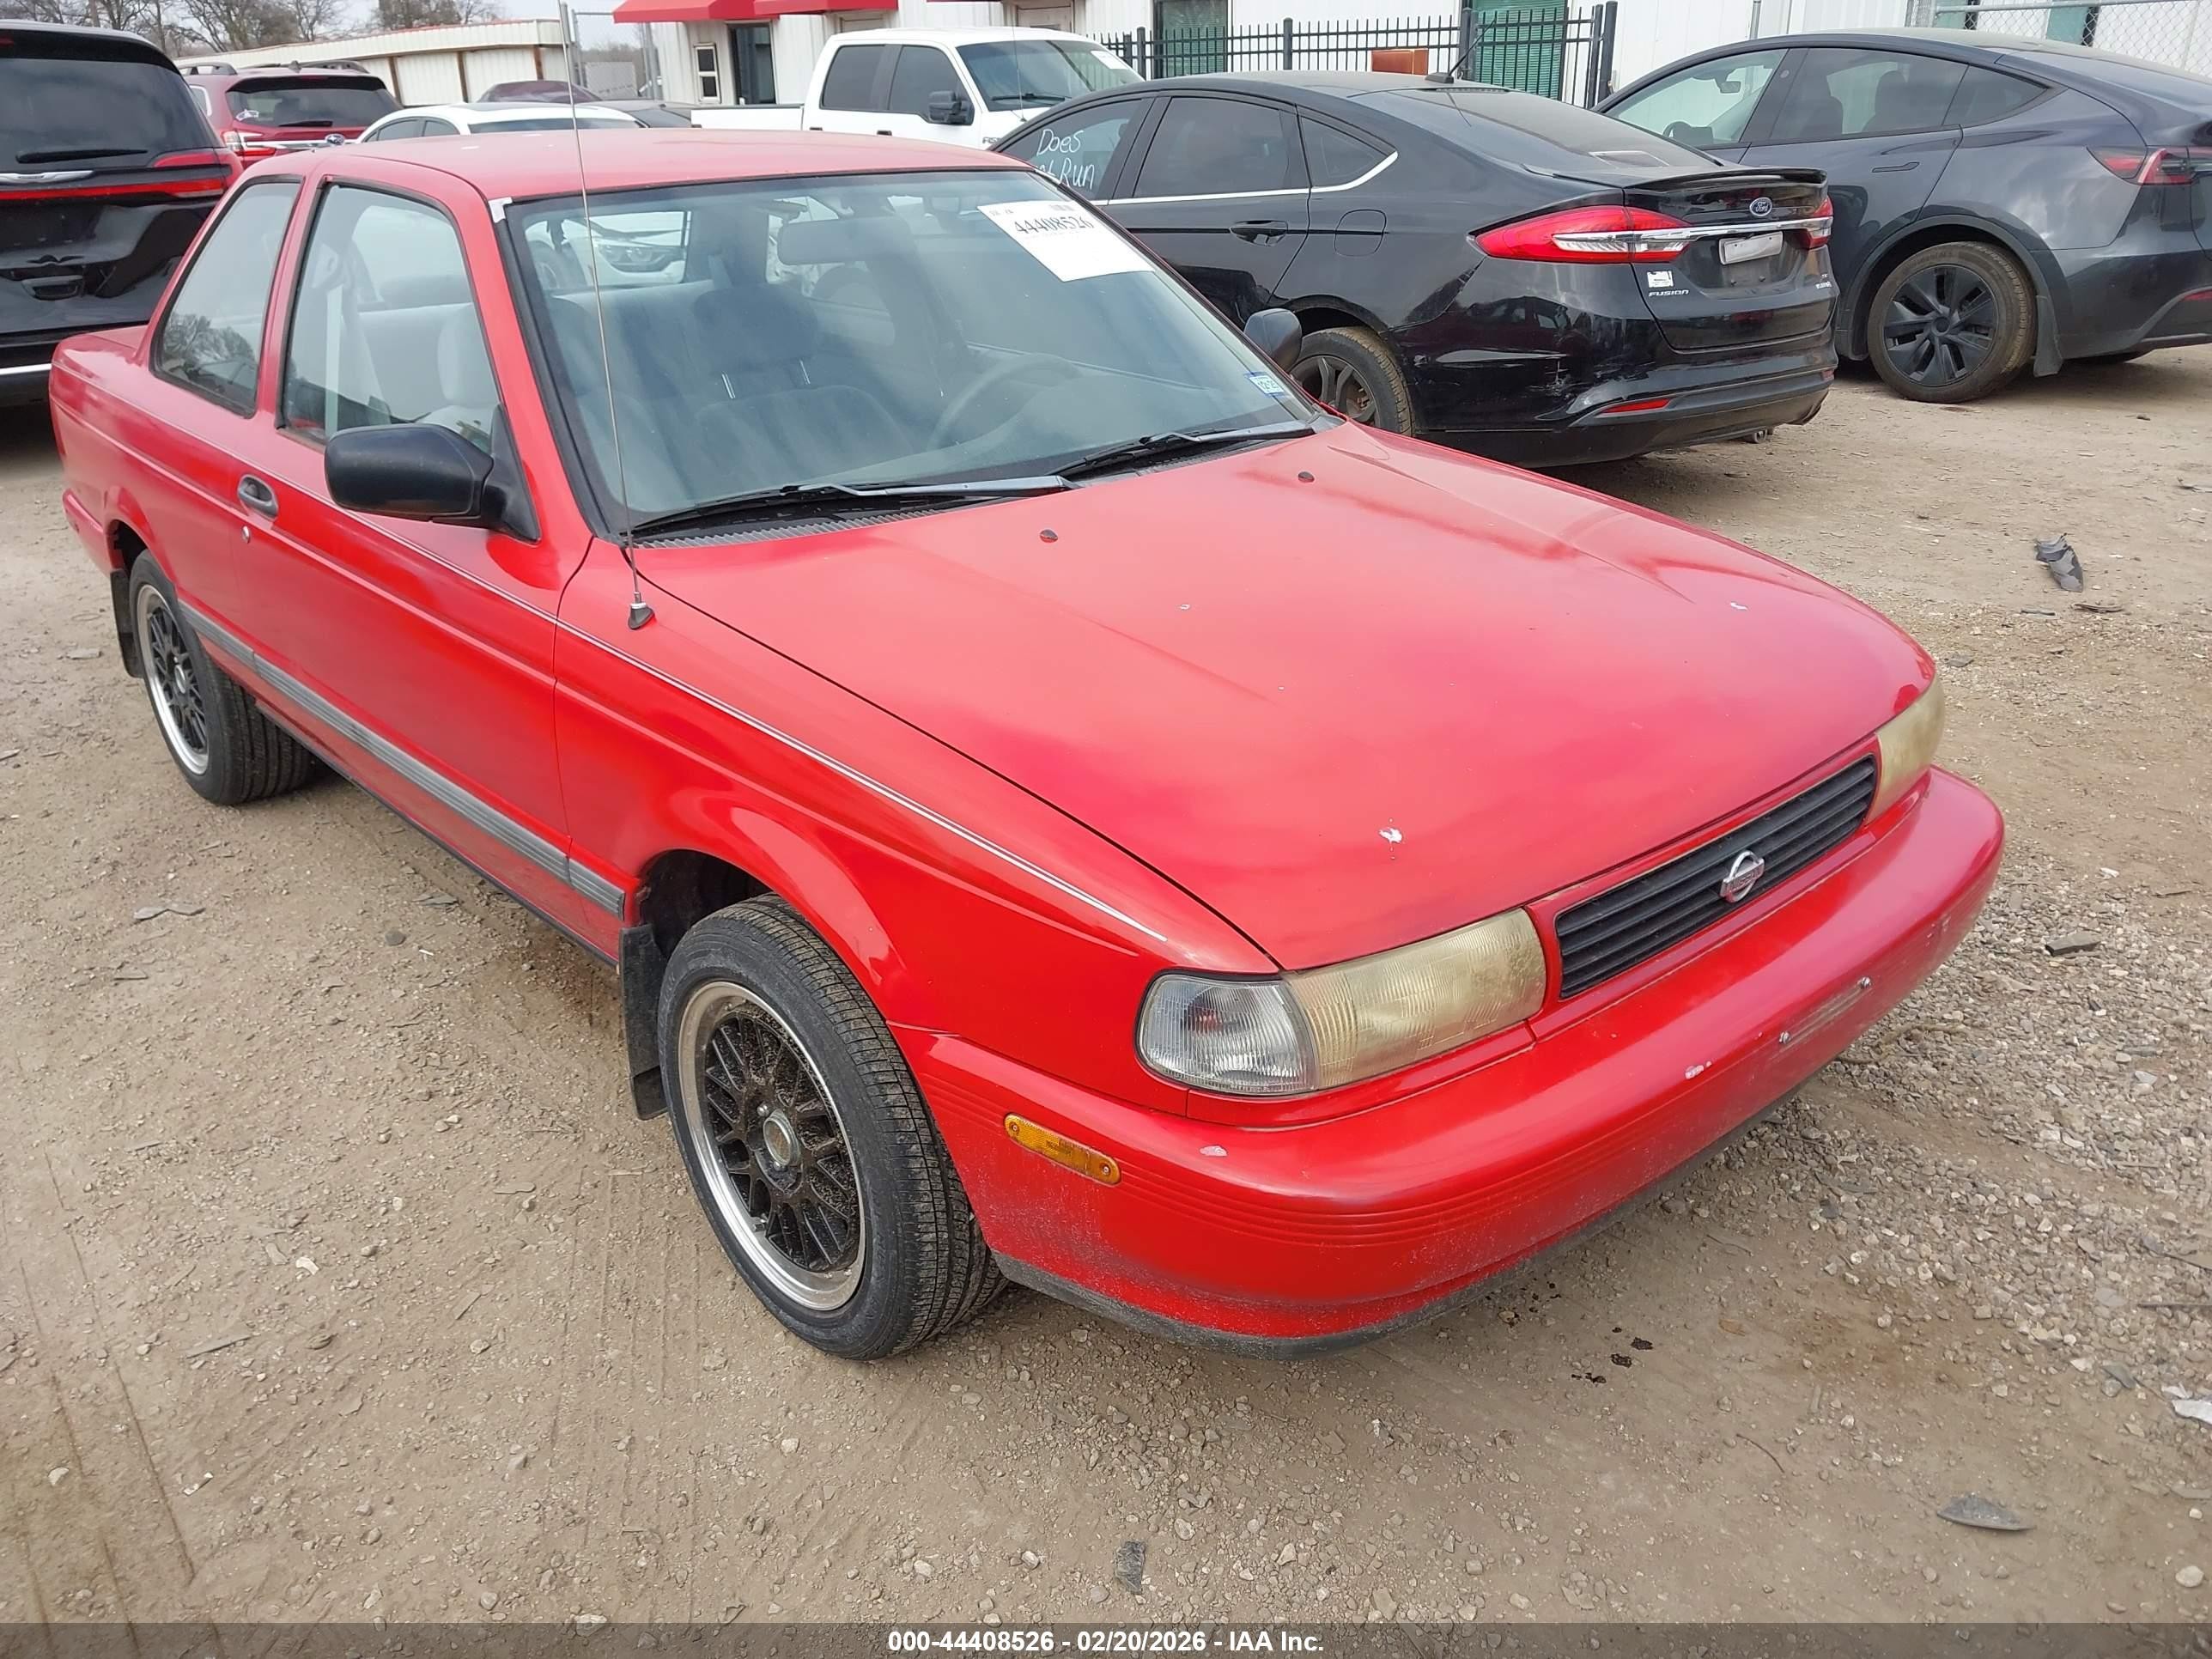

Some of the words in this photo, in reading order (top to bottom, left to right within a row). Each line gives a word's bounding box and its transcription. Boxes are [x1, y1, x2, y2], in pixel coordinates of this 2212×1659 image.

[1036, 129, 1084, 156] Does
[1060, 158, 1095, 190] Run
[1014, 216, 1094, 234] 44408526
